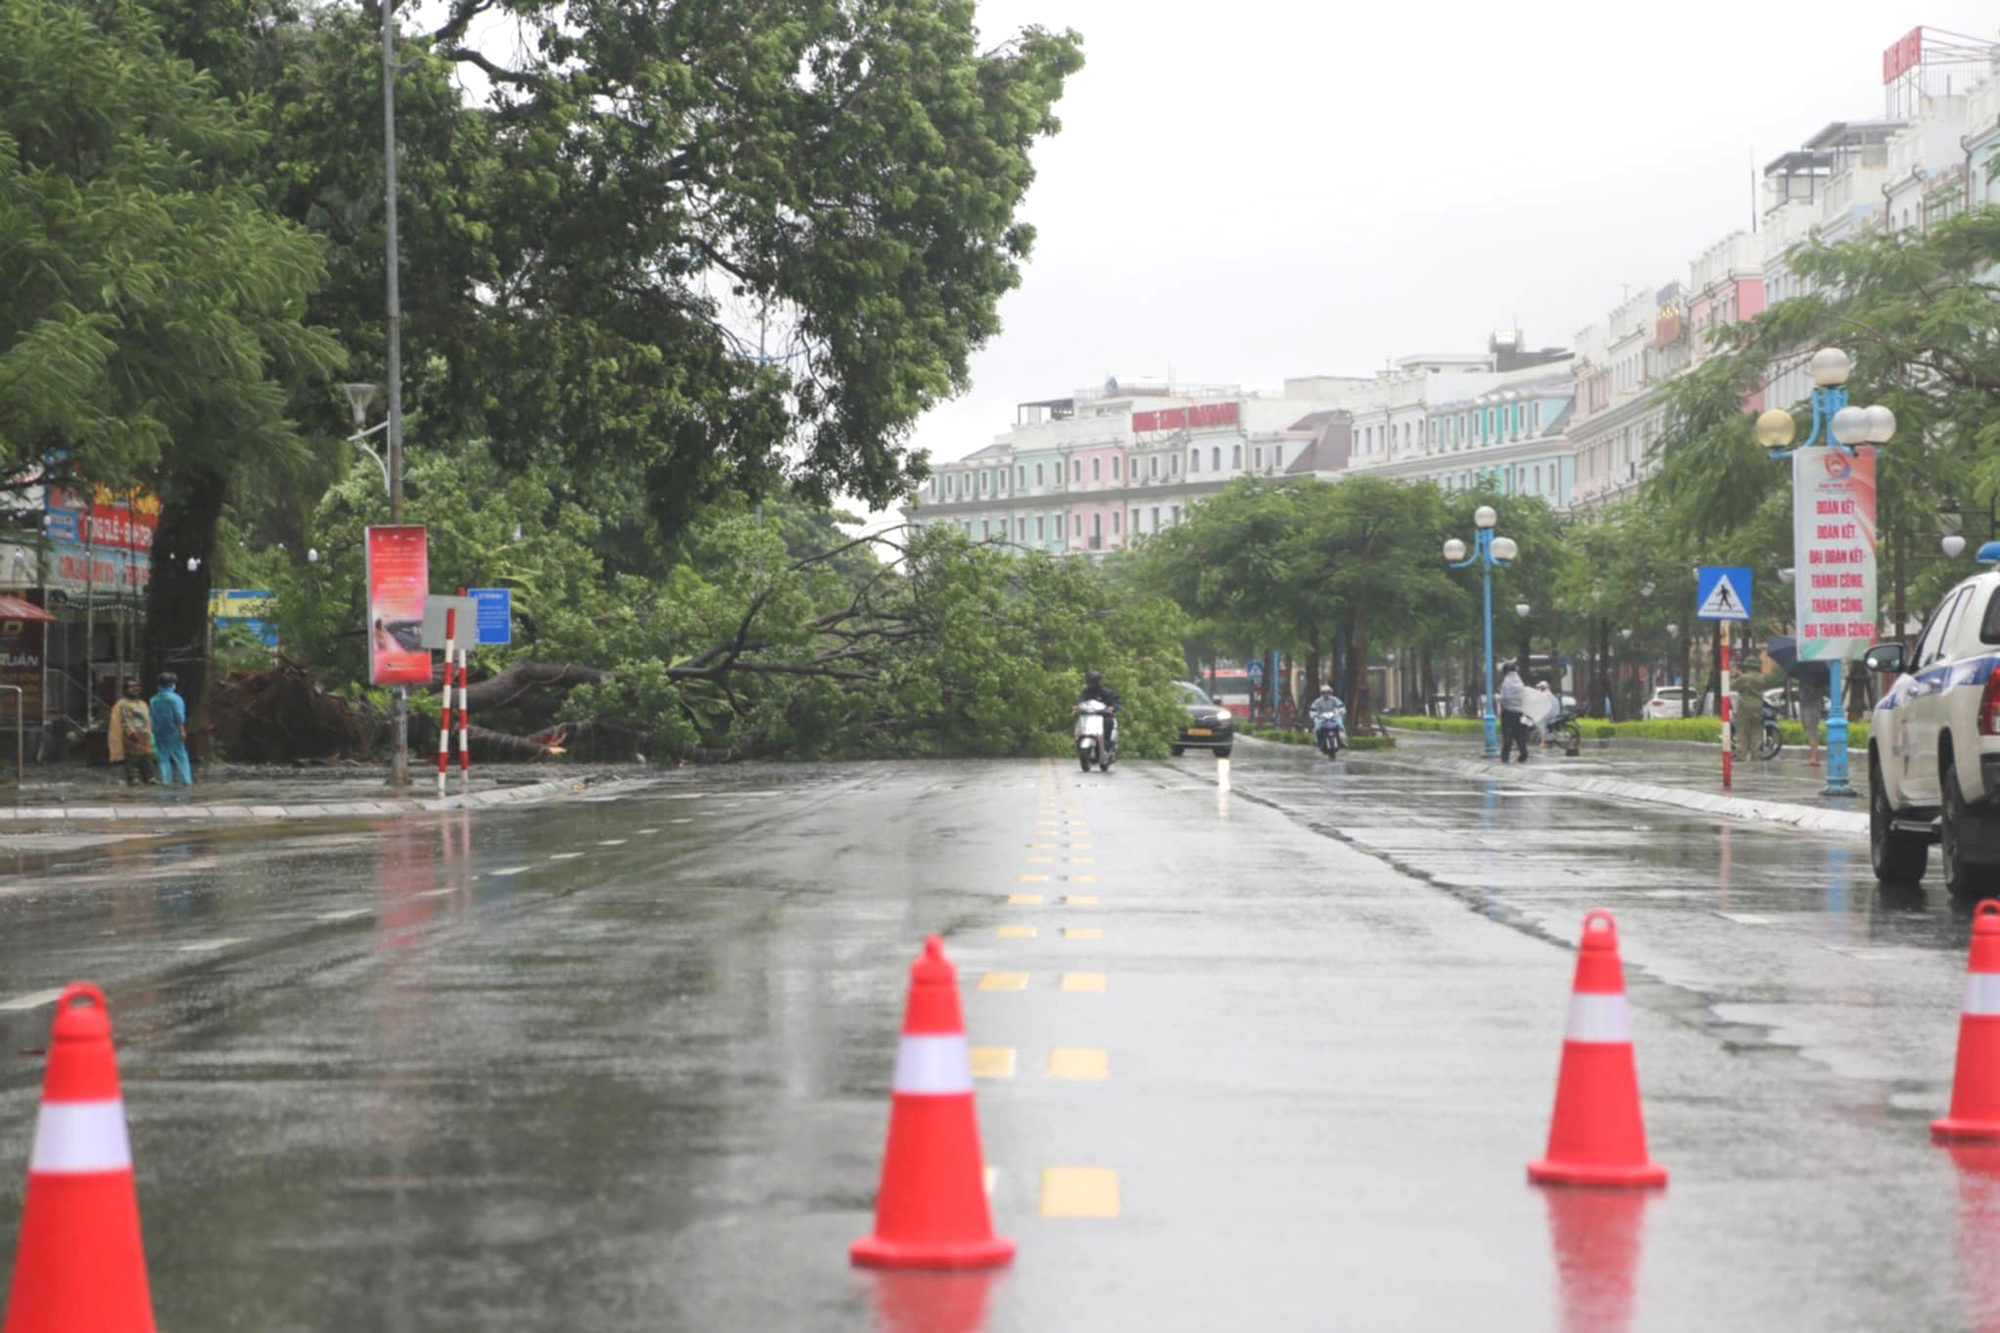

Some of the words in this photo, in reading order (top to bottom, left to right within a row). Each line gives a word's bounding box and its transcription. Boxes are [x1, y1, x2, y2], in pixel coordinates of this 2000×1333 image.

[1811, 572, 1838, 588] THÀNH
[1812, 596, 1838, 613] THÀNH
[1819, 622, 1847, 637] THÀNH
